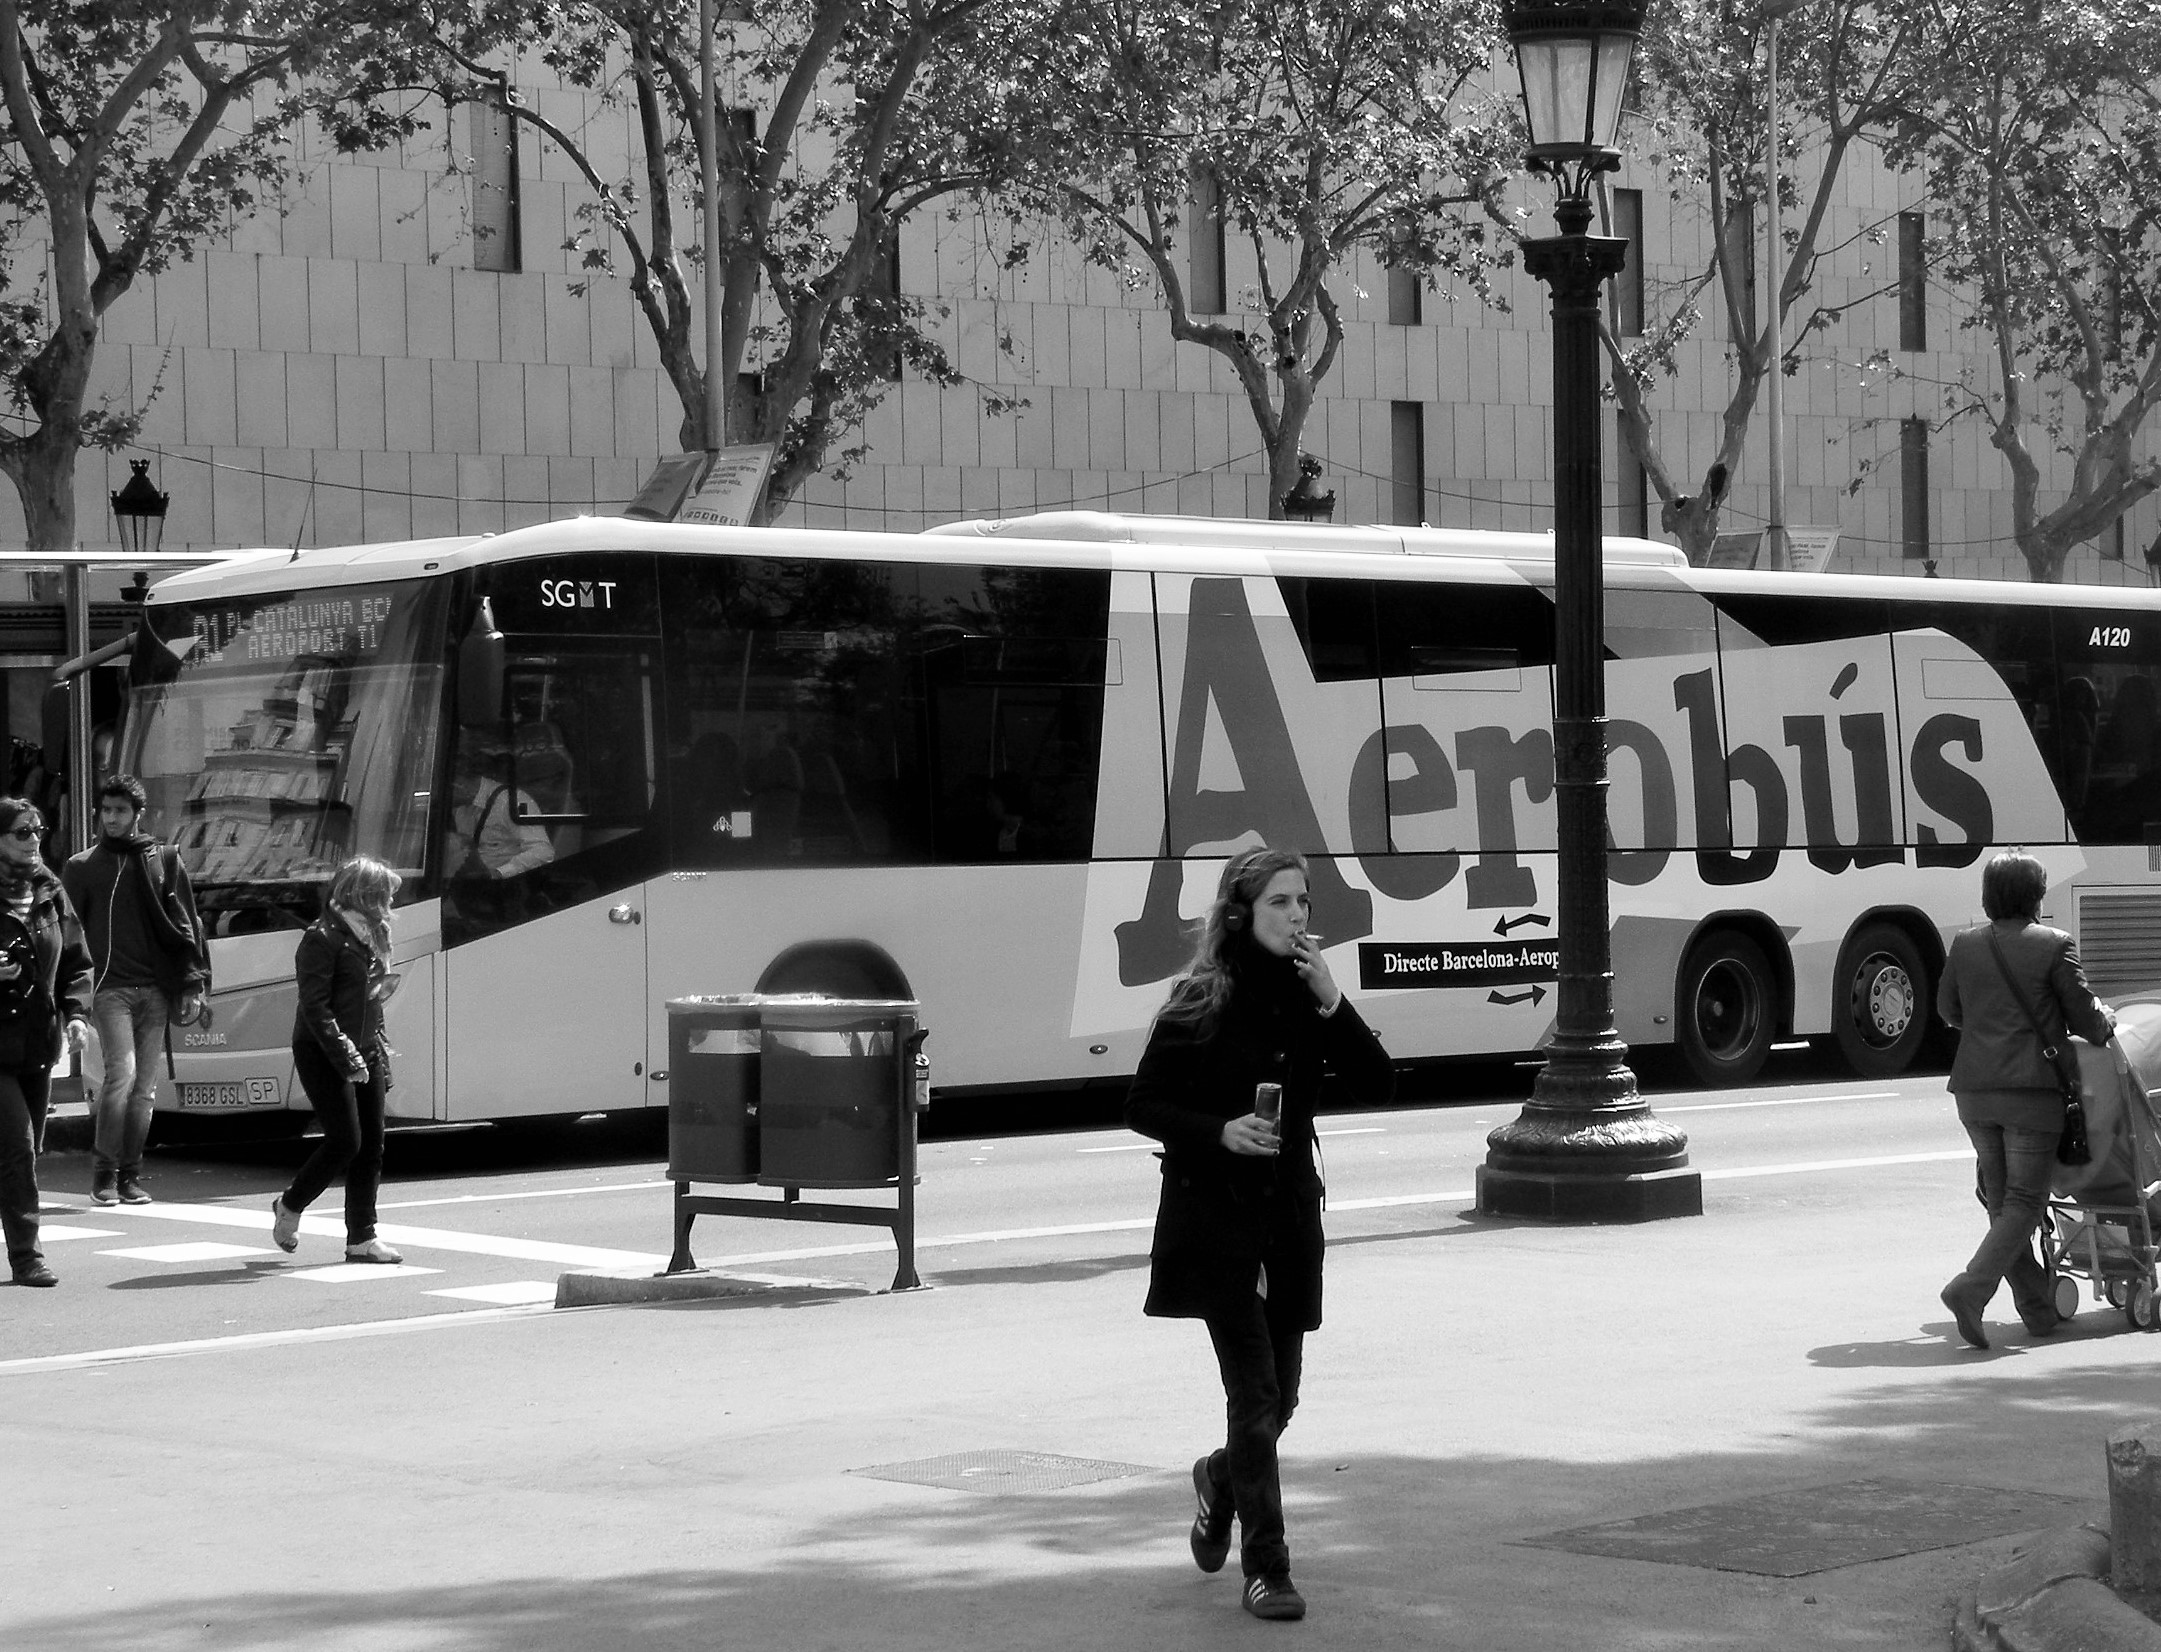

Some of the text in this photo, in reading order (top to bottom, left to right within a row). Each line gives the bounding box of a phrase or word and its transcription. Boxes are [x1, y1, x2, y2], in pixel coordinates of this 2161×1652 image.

[253, 600, 354, 633] CATALUNYA
[247, 624, 378, 659] AEROPORT T1
[2088, 626, 2131, 648] A120
[1115, 576, 1994, 986] Aerobús
[1383, 952, 1439, 974] Directe
[184, 1032, 227, 1047] SCANIA
[186, 1086, 244, 1105] 8368 GSL
[250, 1081, 274, 1101] SP
